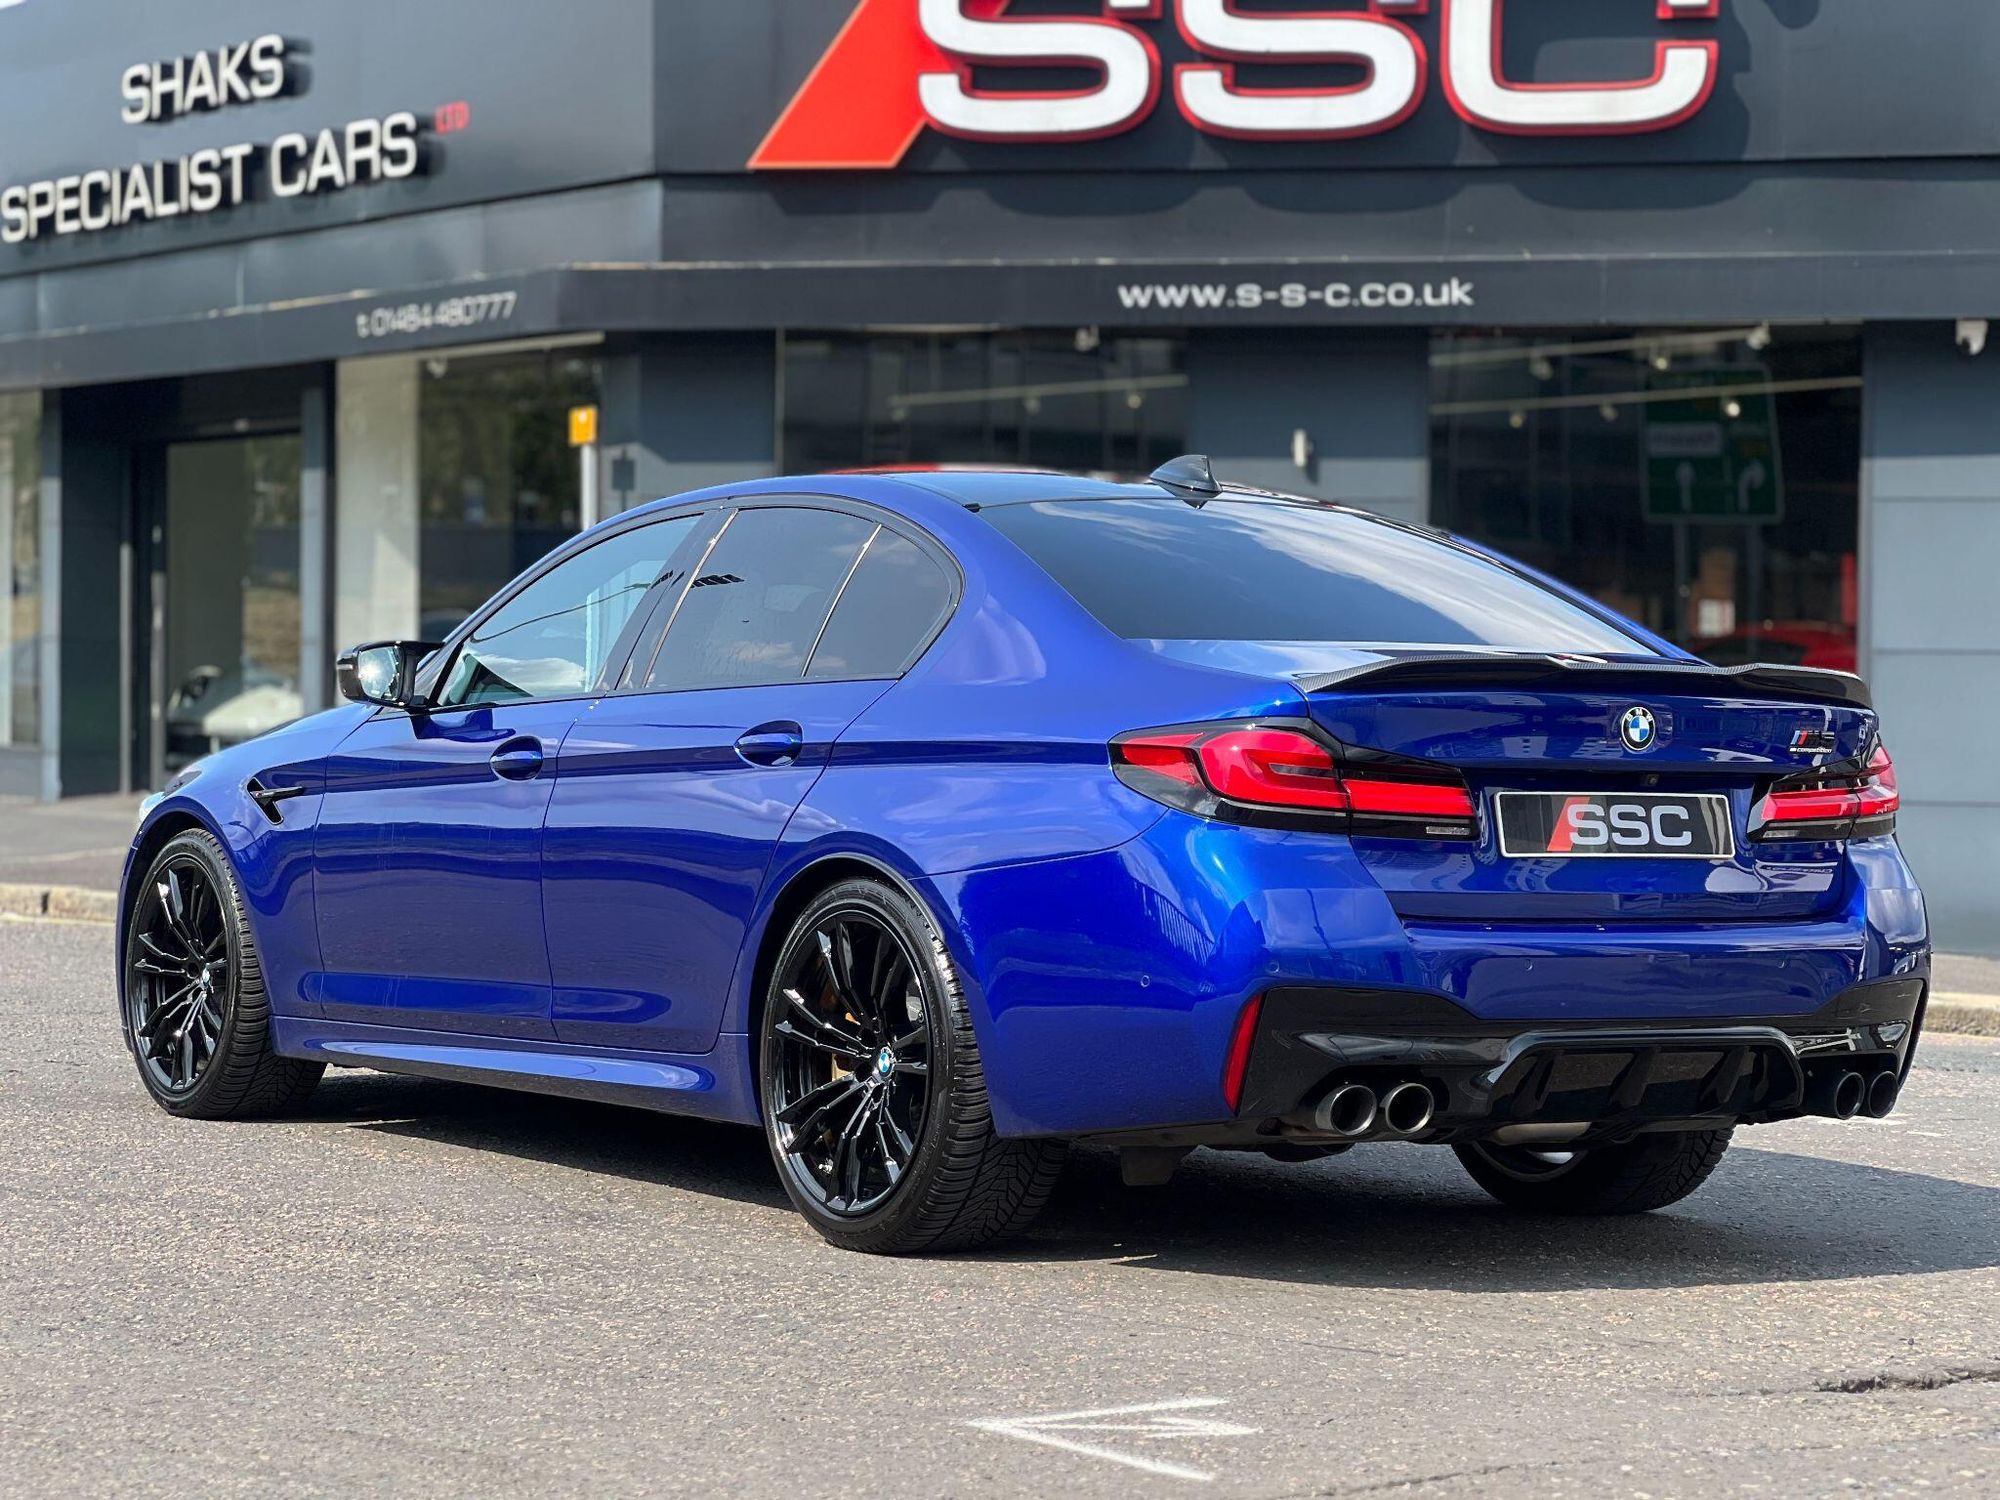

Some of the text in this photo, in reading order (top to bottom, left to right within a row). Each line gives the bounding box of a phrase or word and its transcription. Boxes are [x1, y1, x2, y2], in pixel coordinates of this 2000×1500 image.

[120, 34, 286, 125] SHAKS
[914, 0, 1719, 142] SSC
[0, 142, 255, 244] SPECIALIST
[269, 111, 418, 197] CARS
[1118, 278, 1474, 308] www.s-s-c.co.uk
[1567, 804, 1692, 846] SSC
